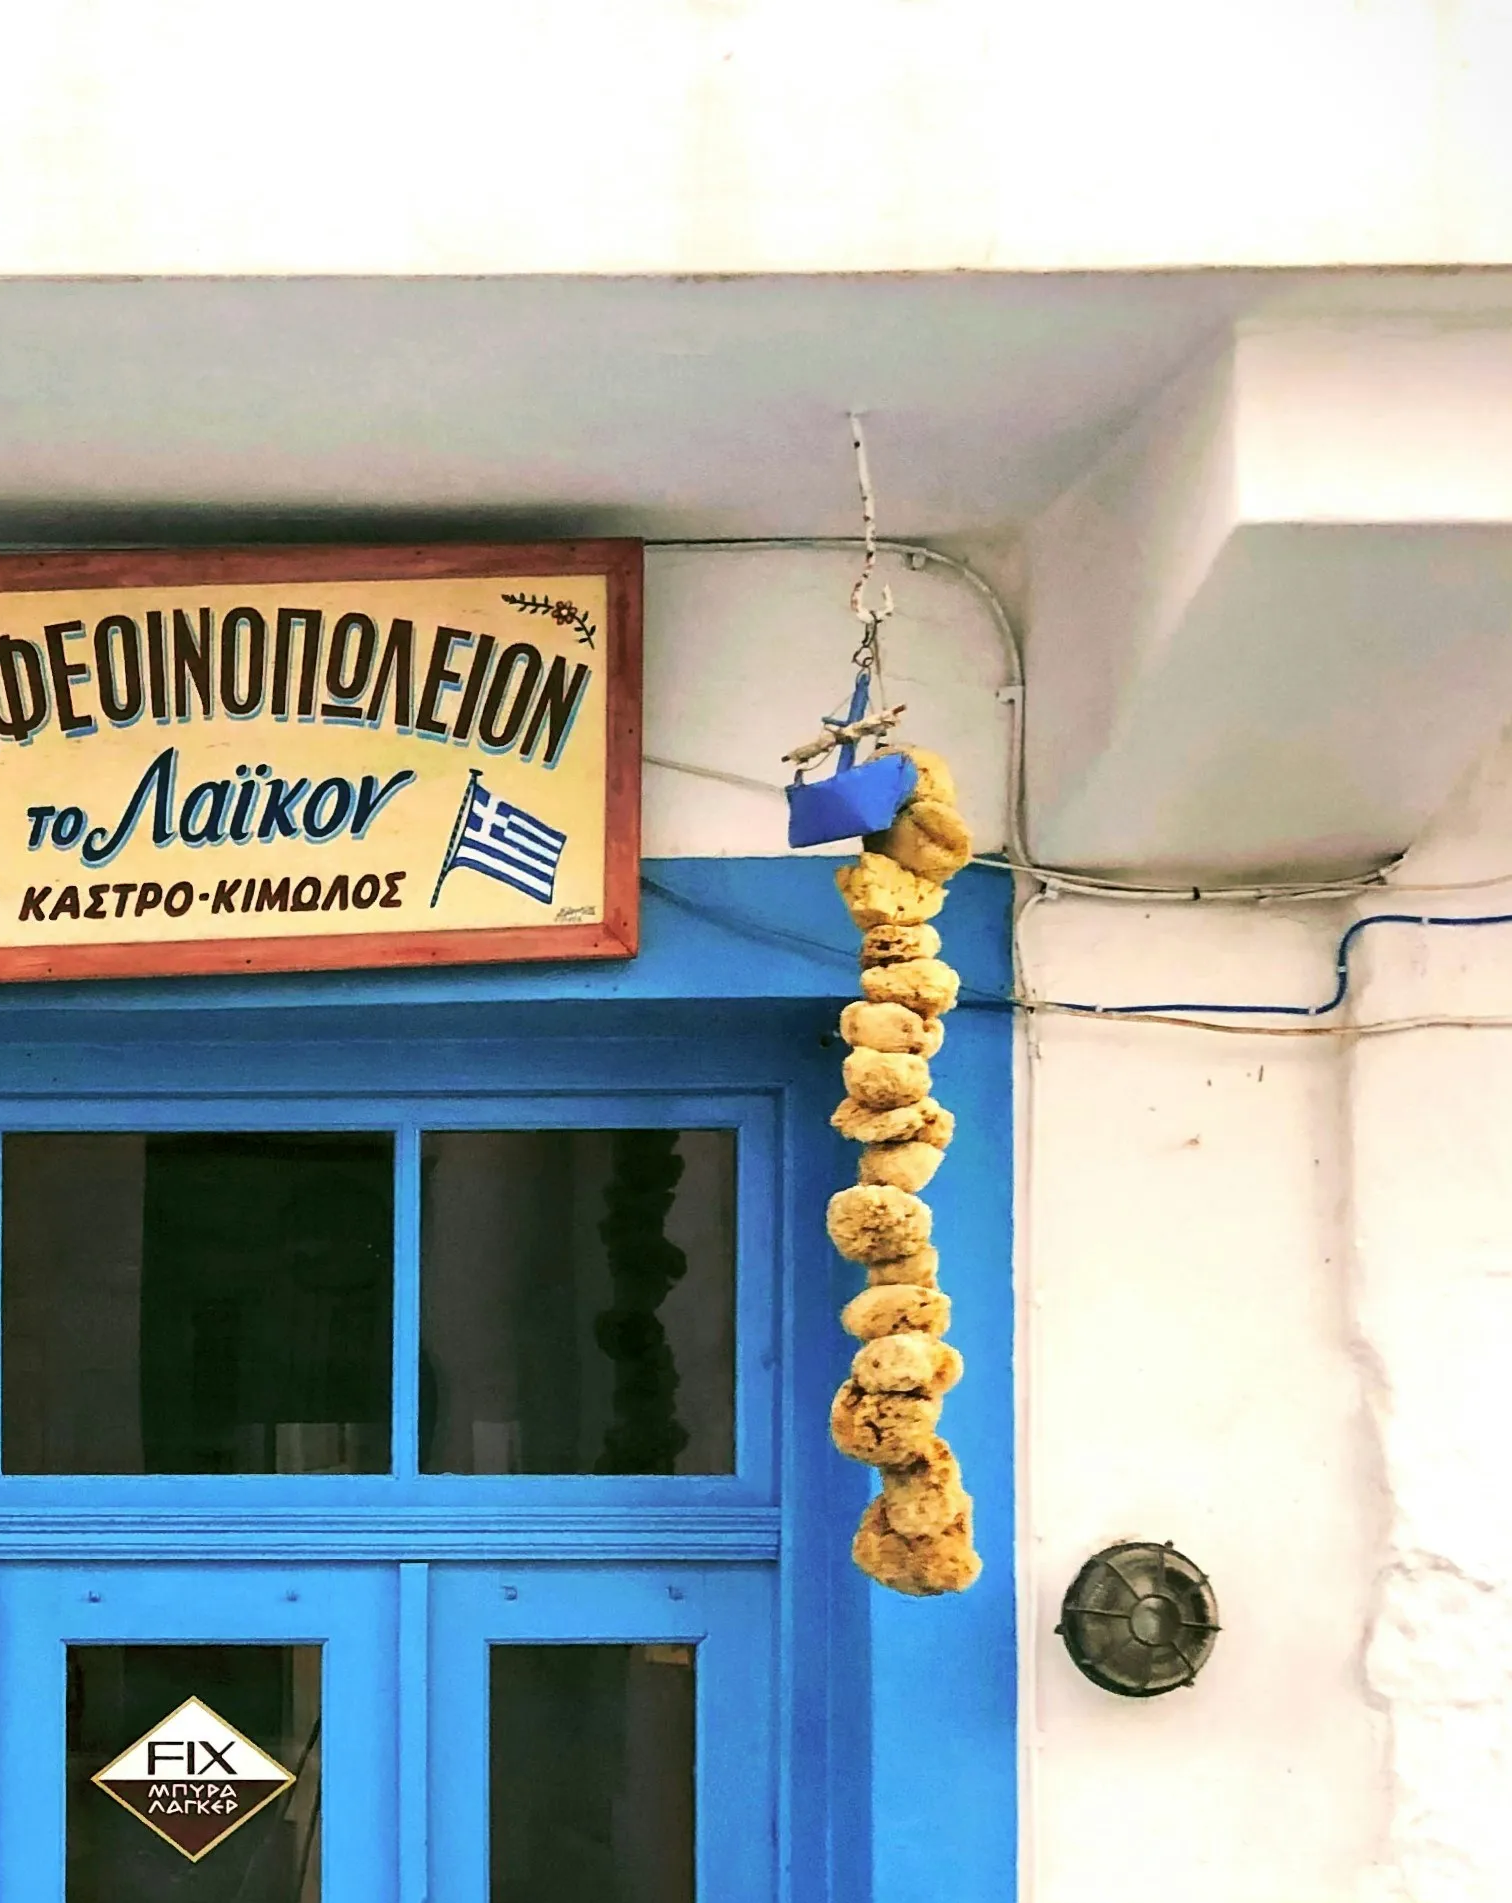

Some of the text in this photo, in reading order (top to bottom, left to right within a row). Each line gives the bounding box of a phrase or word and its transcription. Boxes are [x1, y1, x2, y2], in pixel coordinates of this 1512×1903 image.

[147, 1740, 238, 1776] FIX
[148, 1783, 238, 1799] ΜΠΥΡΑ
[148, 1799, 239, 1815] ΛΑΓΚΕΡ
